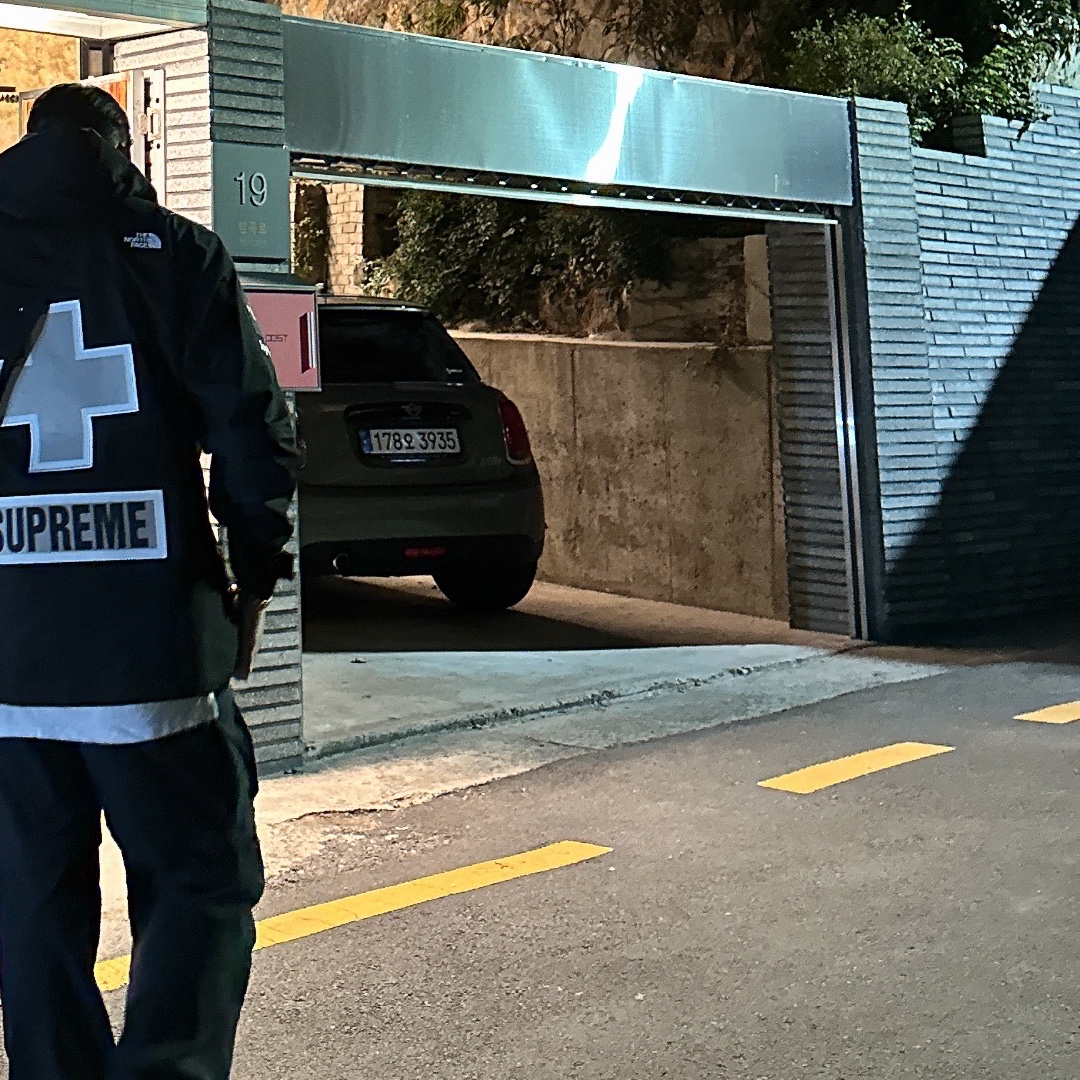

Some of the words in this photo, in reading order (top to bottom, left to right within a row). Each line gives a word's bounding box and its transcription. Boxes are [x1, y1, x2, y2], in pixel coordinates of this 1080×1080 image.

[233, 171, 268, 207] 19
[373, 431, 415, 450] 178오
[417, 431, 456, 450] 3935
